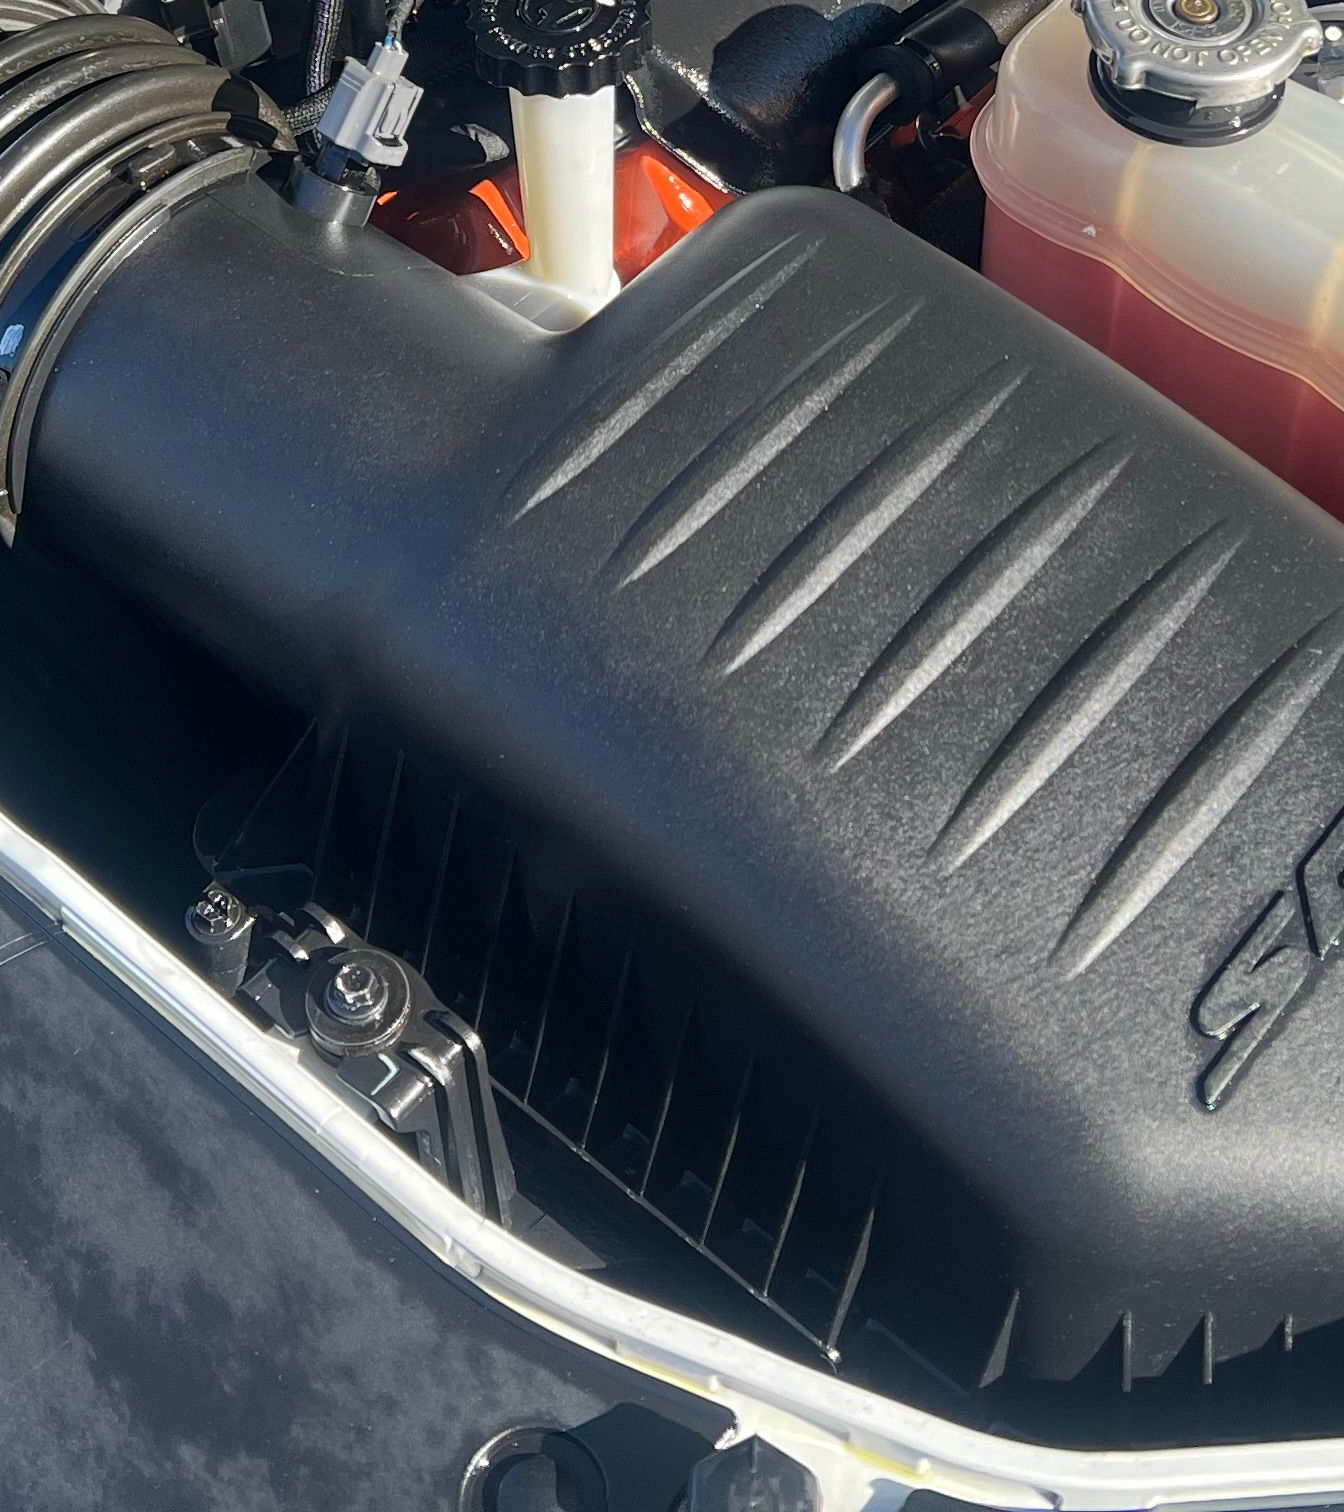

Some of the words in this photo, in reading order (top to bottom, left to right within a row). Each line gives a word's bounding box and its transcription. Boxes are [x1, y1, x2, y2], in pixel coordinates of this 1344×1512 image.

[1116, 18, 1151, 44] DO
[1152, 40, 1210, 67] NOT
[1217, 31, 1284, 65] OPEN
